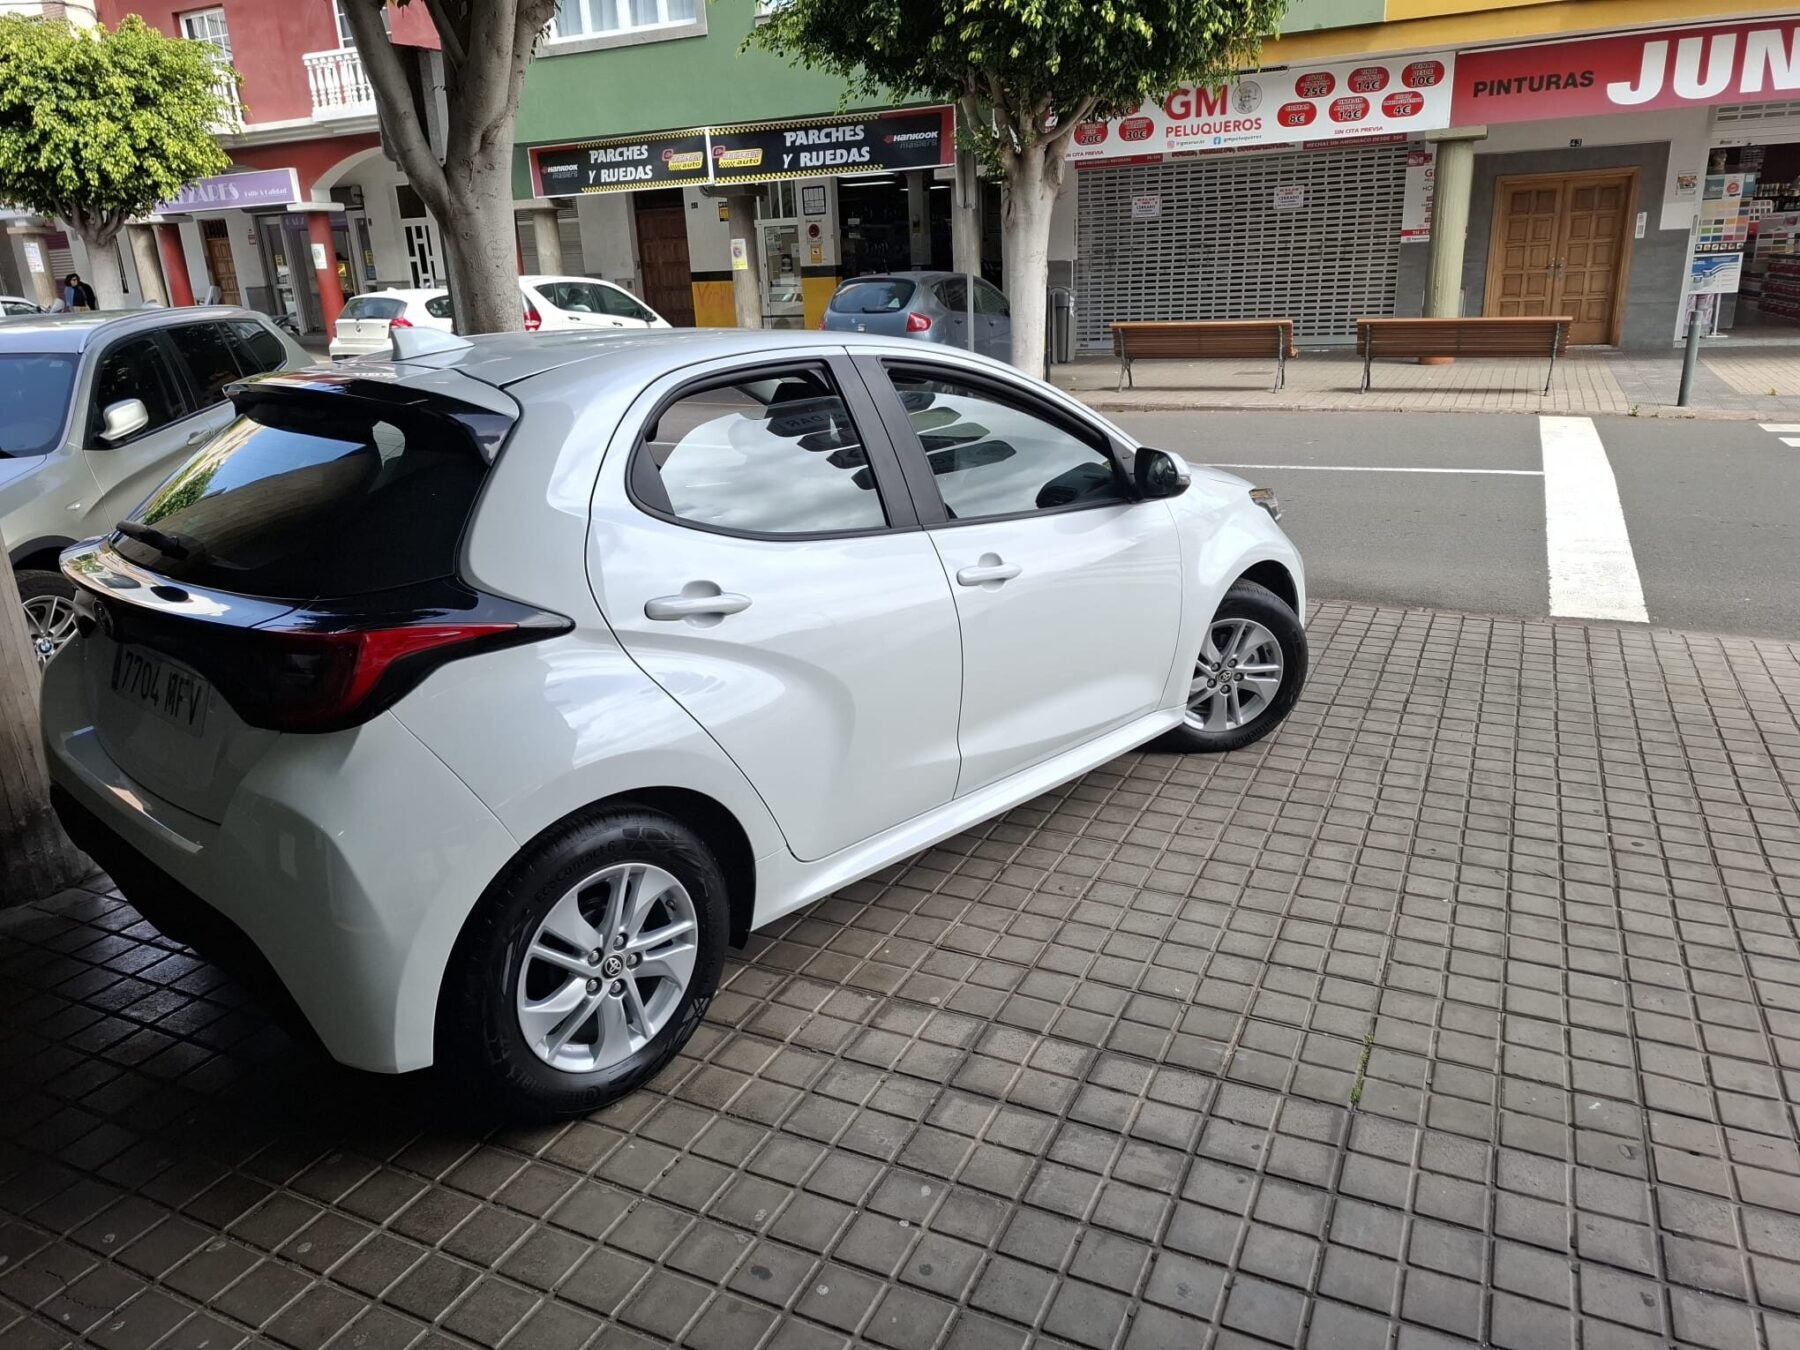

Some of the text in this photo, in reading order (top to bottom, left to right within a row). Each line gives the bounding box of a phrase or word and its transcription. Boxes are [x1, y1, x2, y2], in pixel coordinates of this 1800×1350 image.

[1607, 27, 1800, 105] JUN
[1357, 80, 1379, 91] 14€
[1411, 77, 1435, 87] 10€
[1473, 70, 1595, 98] PINTURAS
[1303, 87, 1327, 97] 25€
[1165, 85, 1228, 120] GM
[1394, 104, 1411, 115] 4€
[1289, 114, 1305, 124] 8€
[1339, 109, 1360, 120] 14€
[784, 125, 865, 147] PARCHES
[1127, 130, 1147, 140] 30€
[1166, 117, 1262, 138] PELUQUEROS
[1082, 134, 1102, 144] 20€
[588, 145, 649, 164] PARCHES
[783, 146, 870, 169] Y RUEDAS
[588, 165, 653, 185] Y RUEDAS
[121, 650, 202, 726] 7704 MFV
